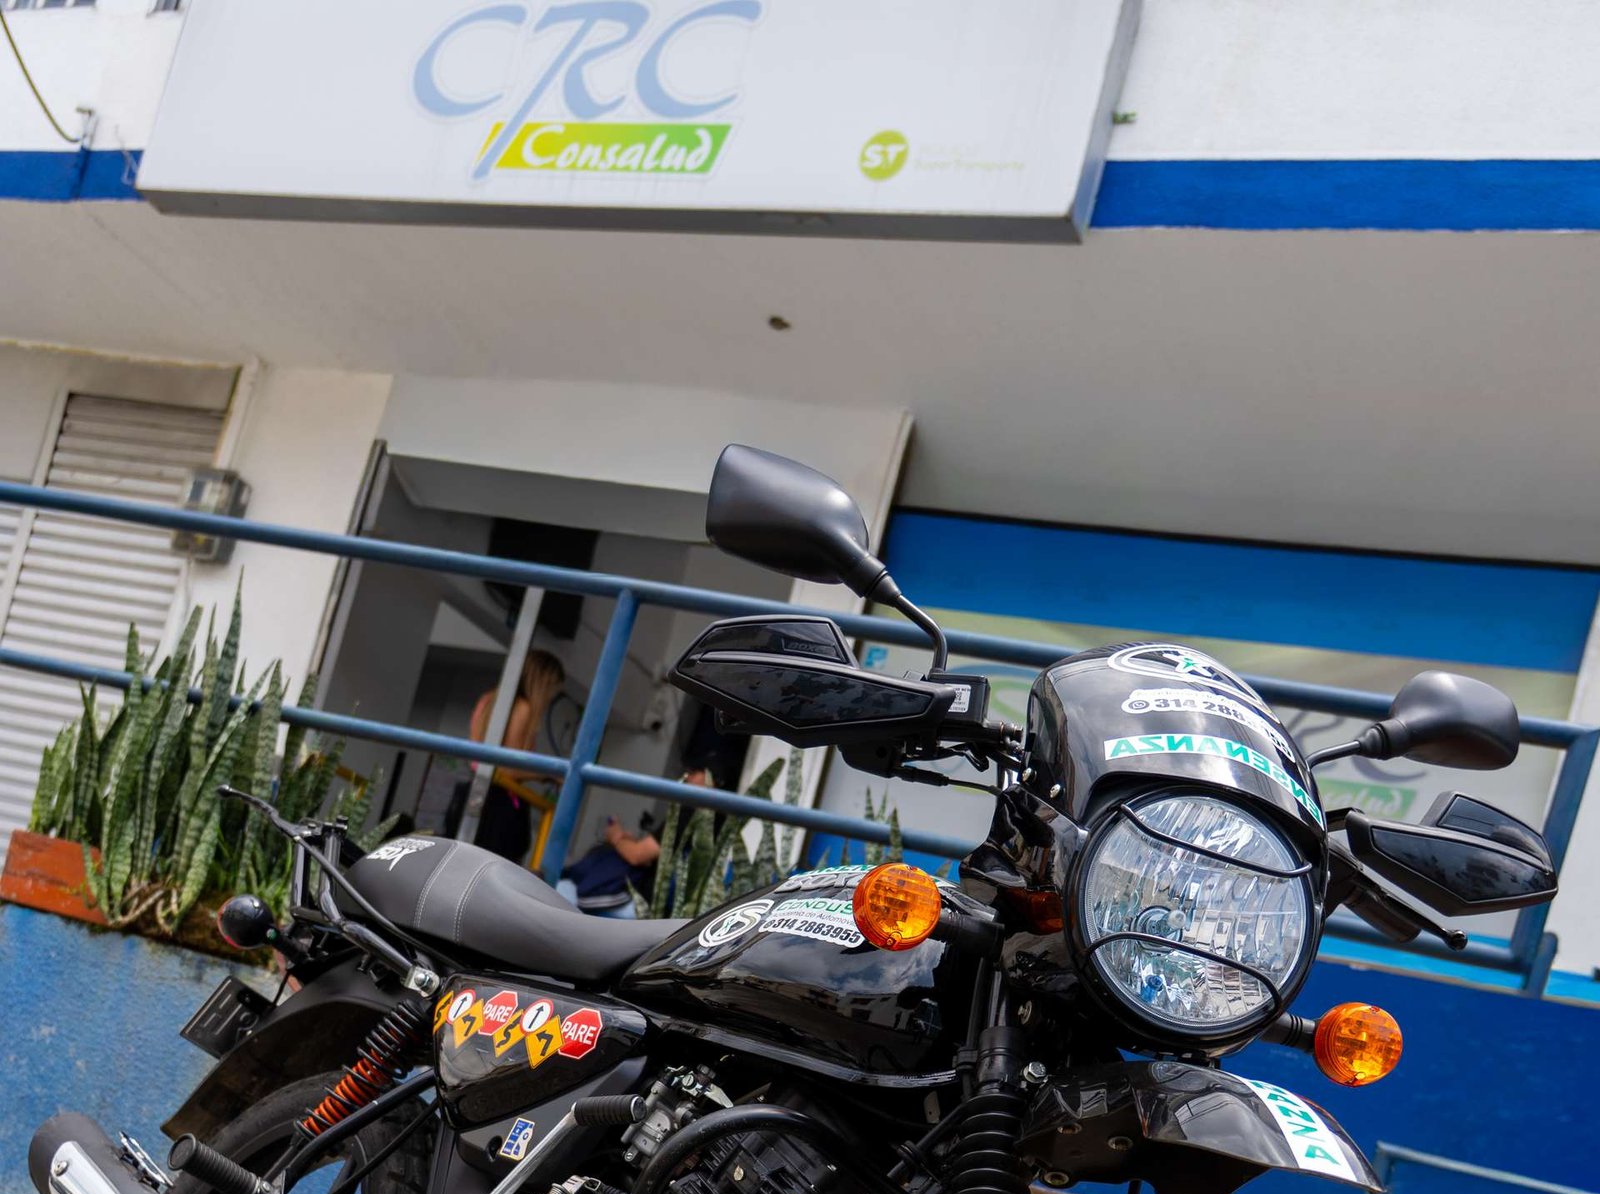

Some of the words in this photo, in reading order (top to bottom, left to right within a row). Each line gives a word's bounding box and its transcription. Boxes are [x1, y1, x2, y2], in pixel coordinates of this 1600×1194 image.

[413, 0, 761, 180] CRC
[522, 124, 713, 171] Consalud
[863, 143, 908, 168] ST
[1154, 698, 1198, 708] 314
[773, 918, 799, 929] 314
[795, 920, 861, 944] 2883955
[483, 1003, 513, 1023] PARE
[561, 1021, 597, 1045] PARE
